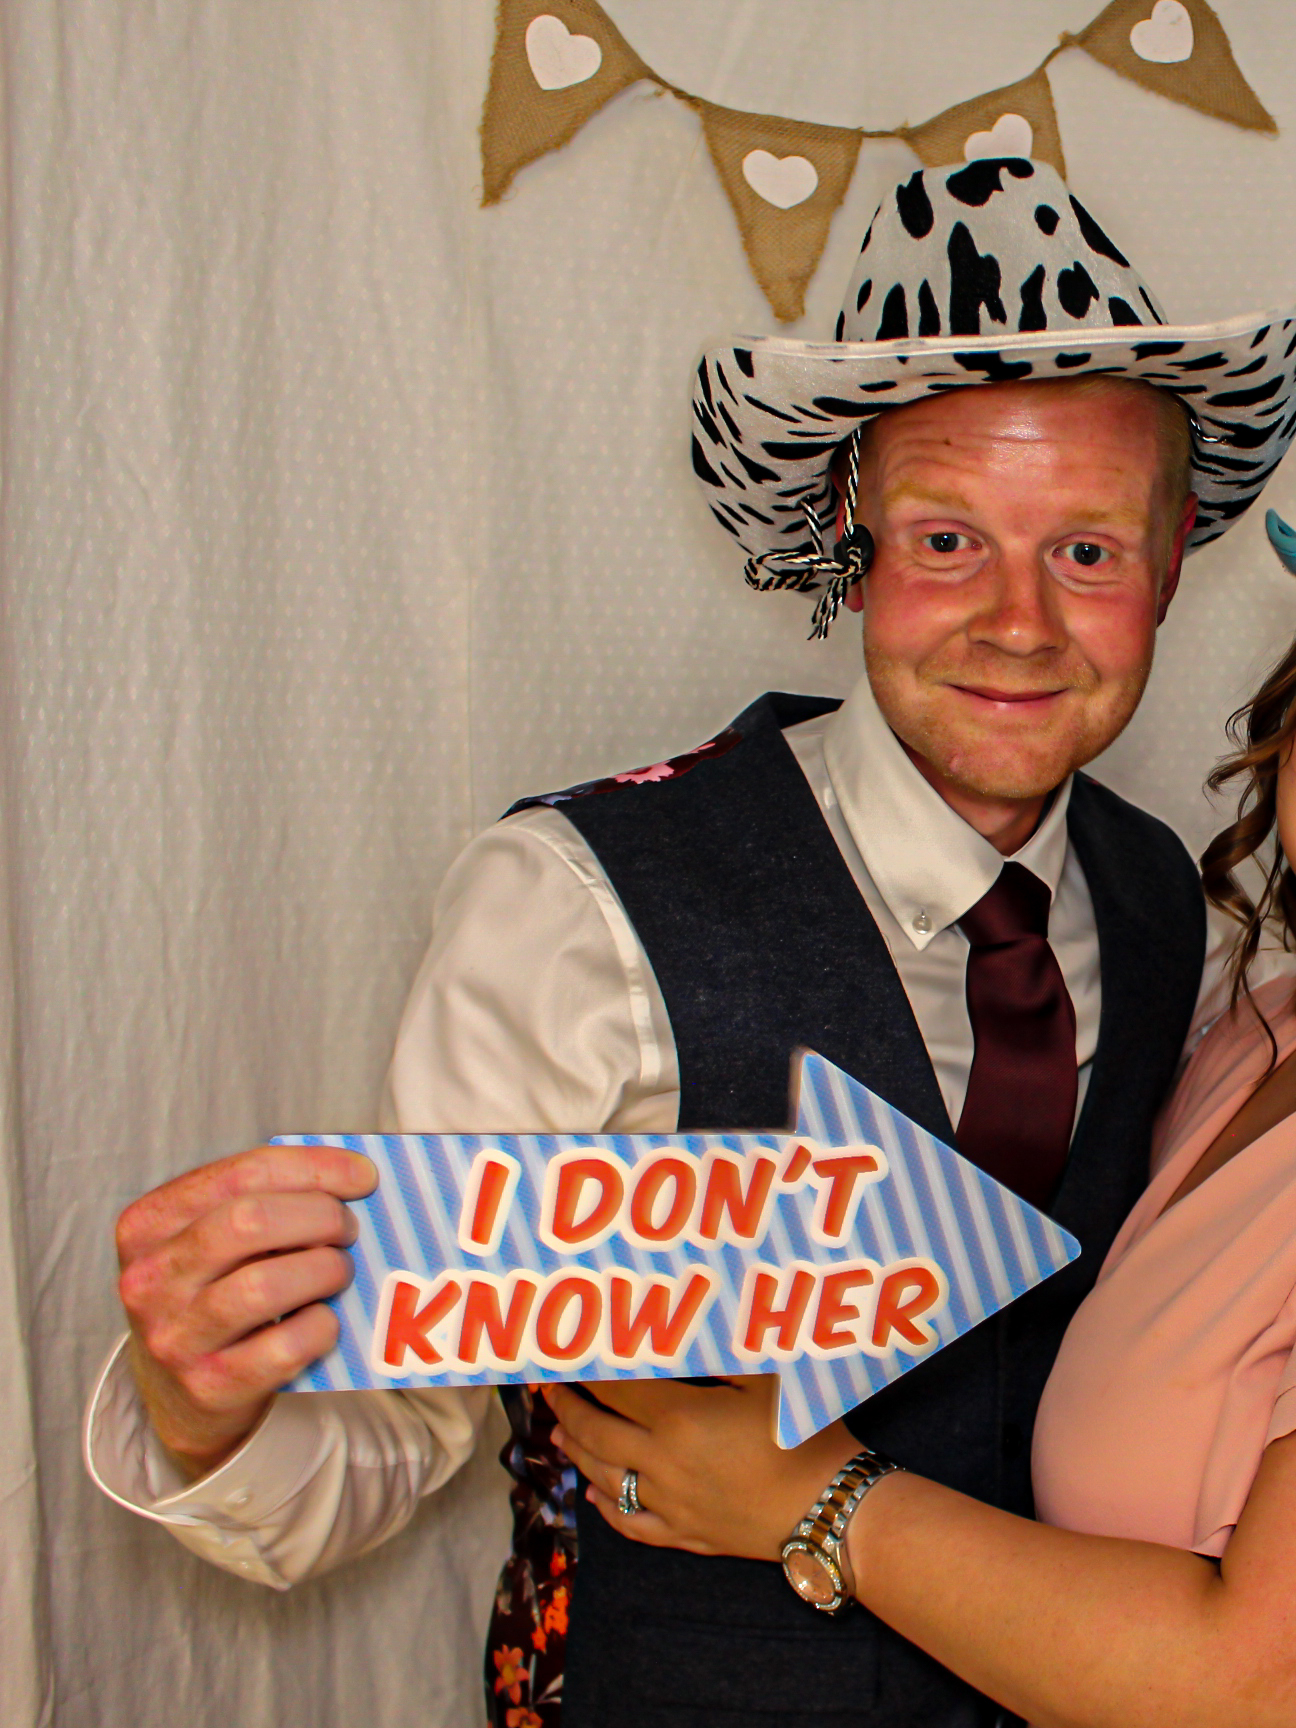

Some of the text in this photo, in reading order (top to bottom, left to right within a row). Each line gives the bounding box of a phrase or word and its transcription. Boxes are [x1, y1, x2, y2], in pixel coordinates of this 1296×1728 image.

[471, 1145, 879, 1245] I DON'T
[383, 1266, 940, 1367] KNOW HER
